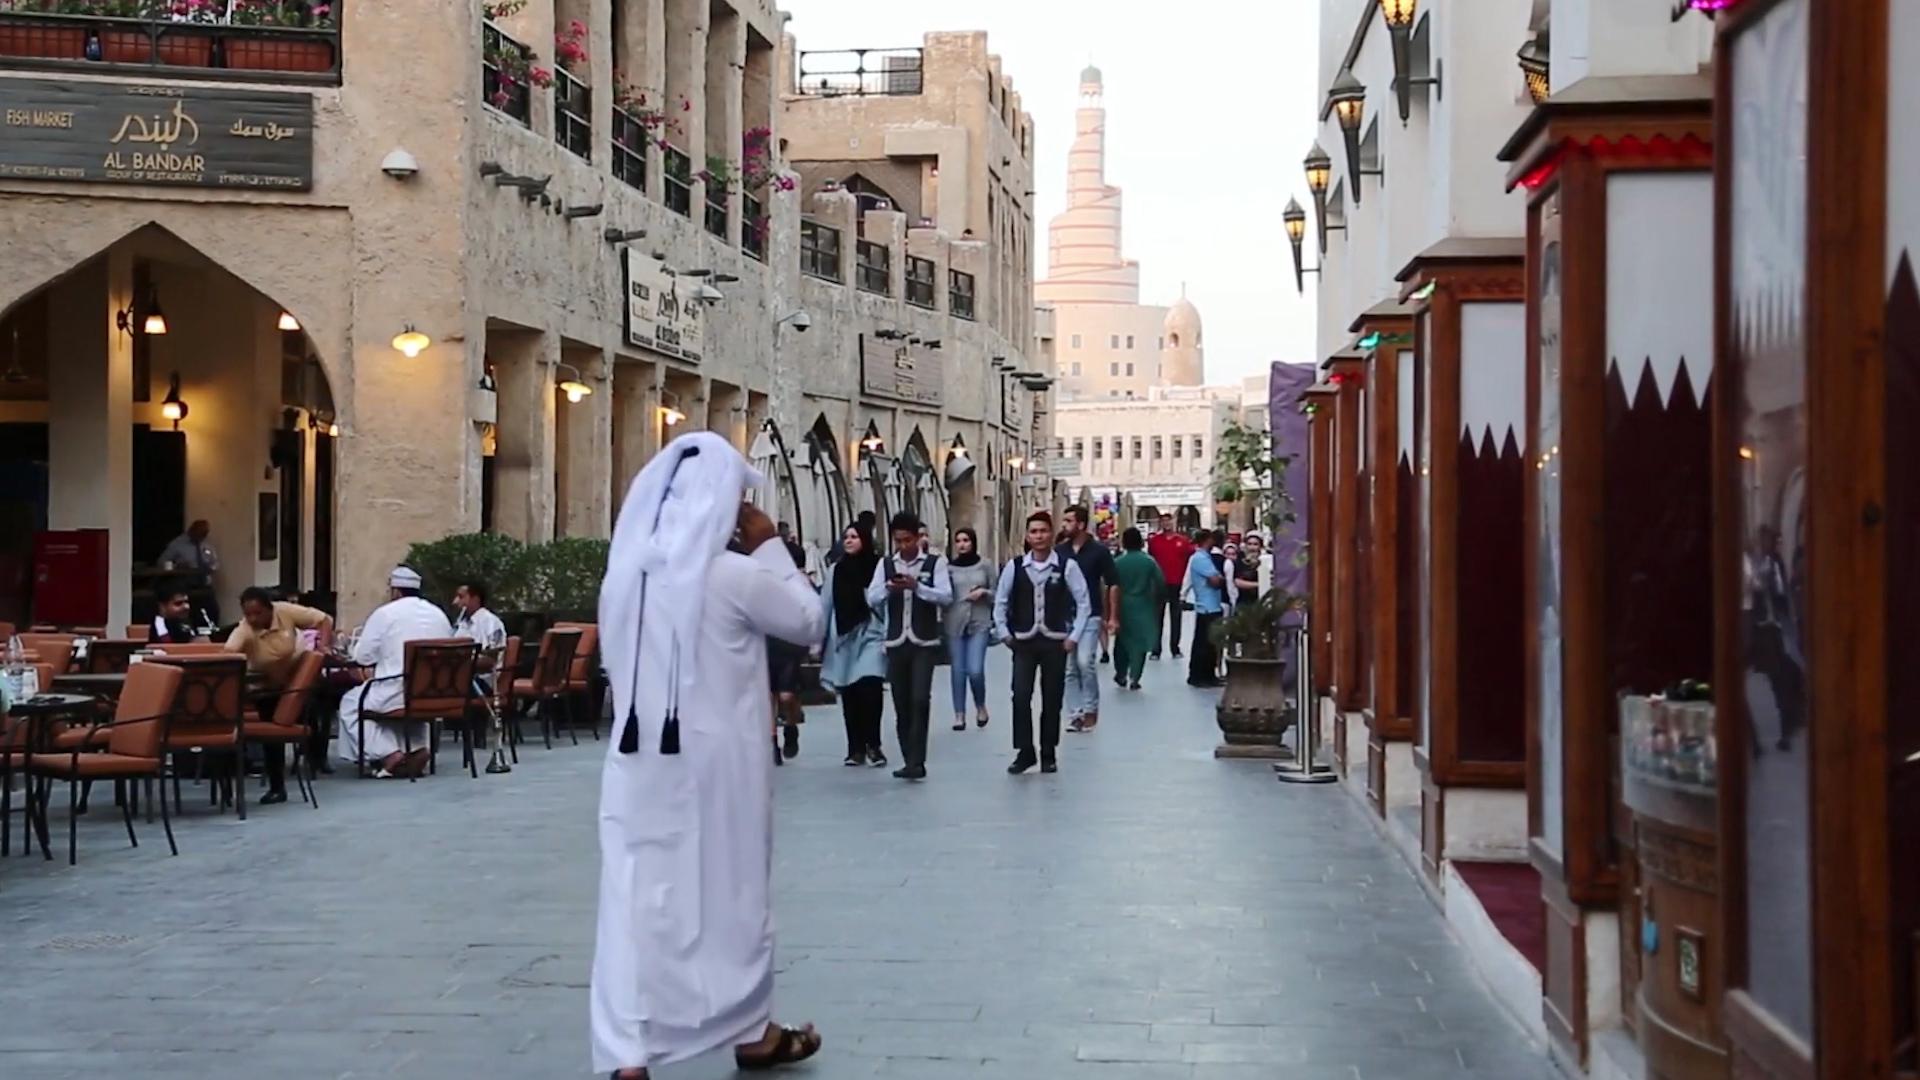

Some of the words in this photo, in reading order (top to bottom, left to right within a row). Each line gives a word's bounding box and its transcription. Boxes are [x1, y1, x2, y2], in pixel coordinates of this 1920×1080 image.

[6, 109, 30, 126] FISH
[33, 110, 75, 128] MARKET
[109, 99, 199, 151] البندر
[229, 118, 263, 137] سمك
[264, 121, 295, 141] سوق
[104, 152, 126, 169] AL
[133, 152, 205, 172] BANDAR
[133, 171, 145, 180] OF
